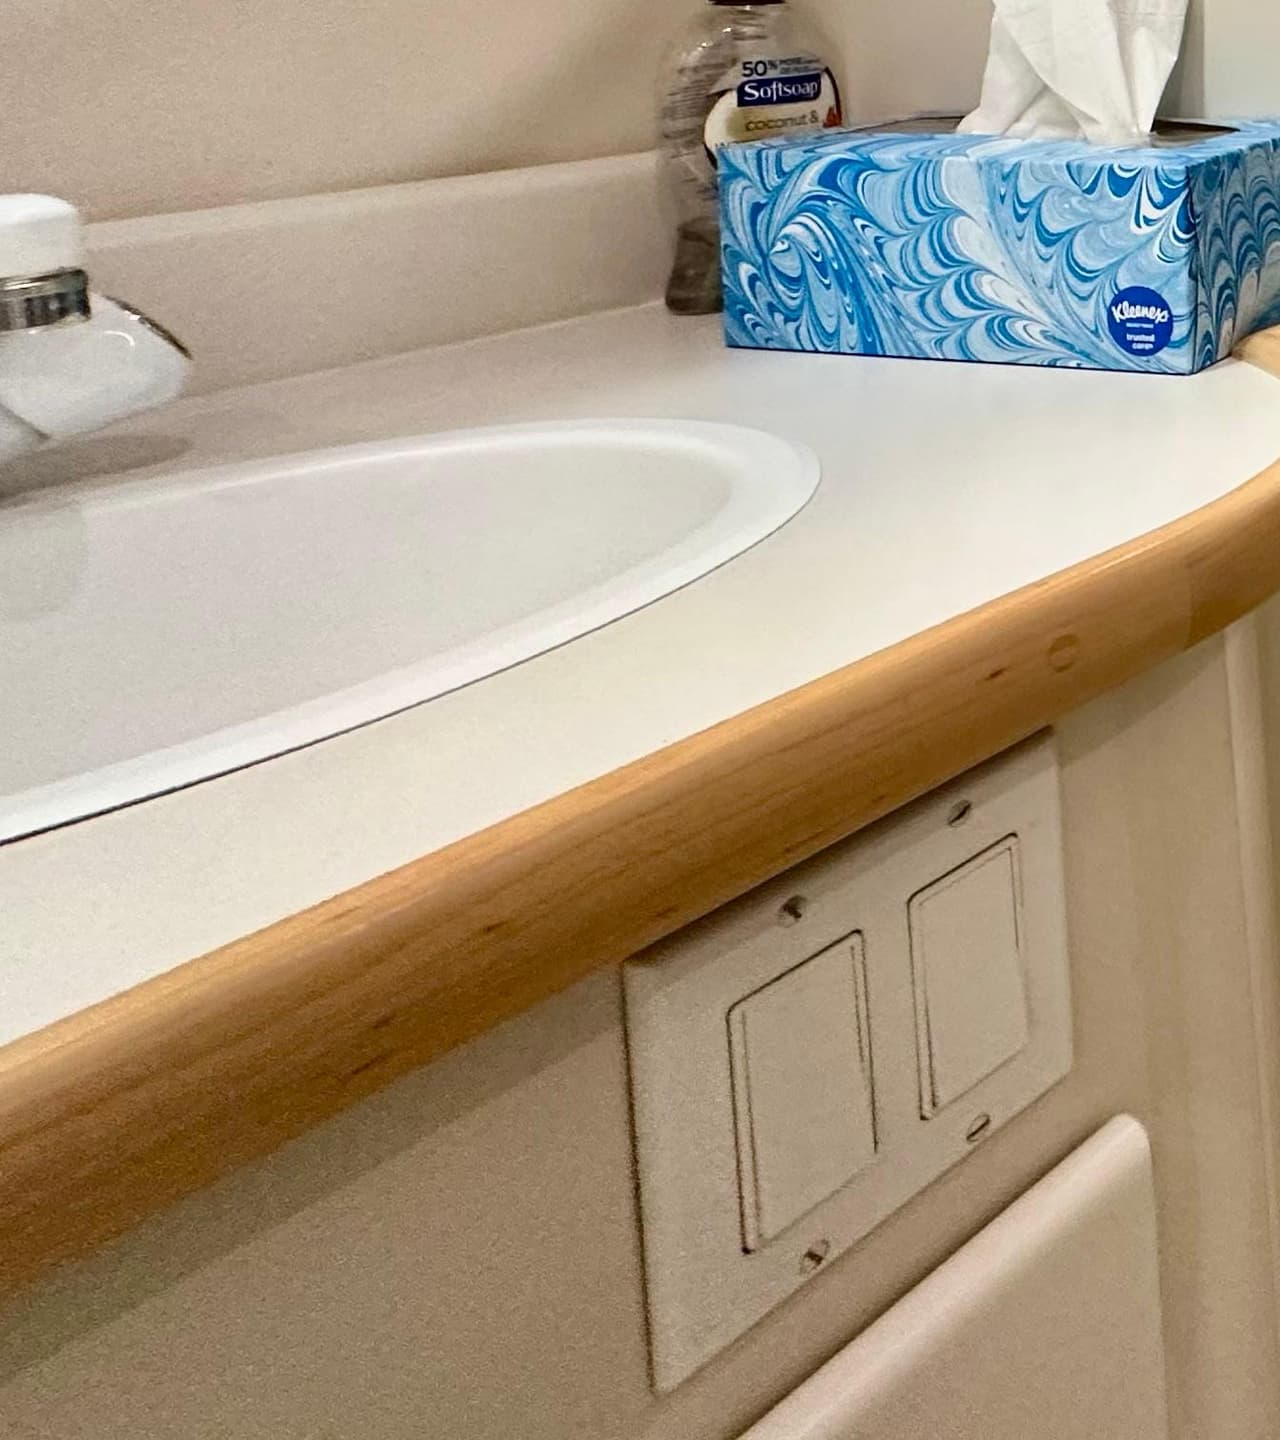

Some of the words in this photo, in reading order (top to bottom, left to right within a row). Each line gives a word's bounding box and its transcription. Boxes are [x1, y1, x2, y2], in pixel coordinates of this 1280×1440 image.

[744, 81, 818, 102] Softsoap
[746, 115, 808, 131] coconut
[810, 110, 819, 123] &
[1112, 301, 1169, 323] Kleenex
